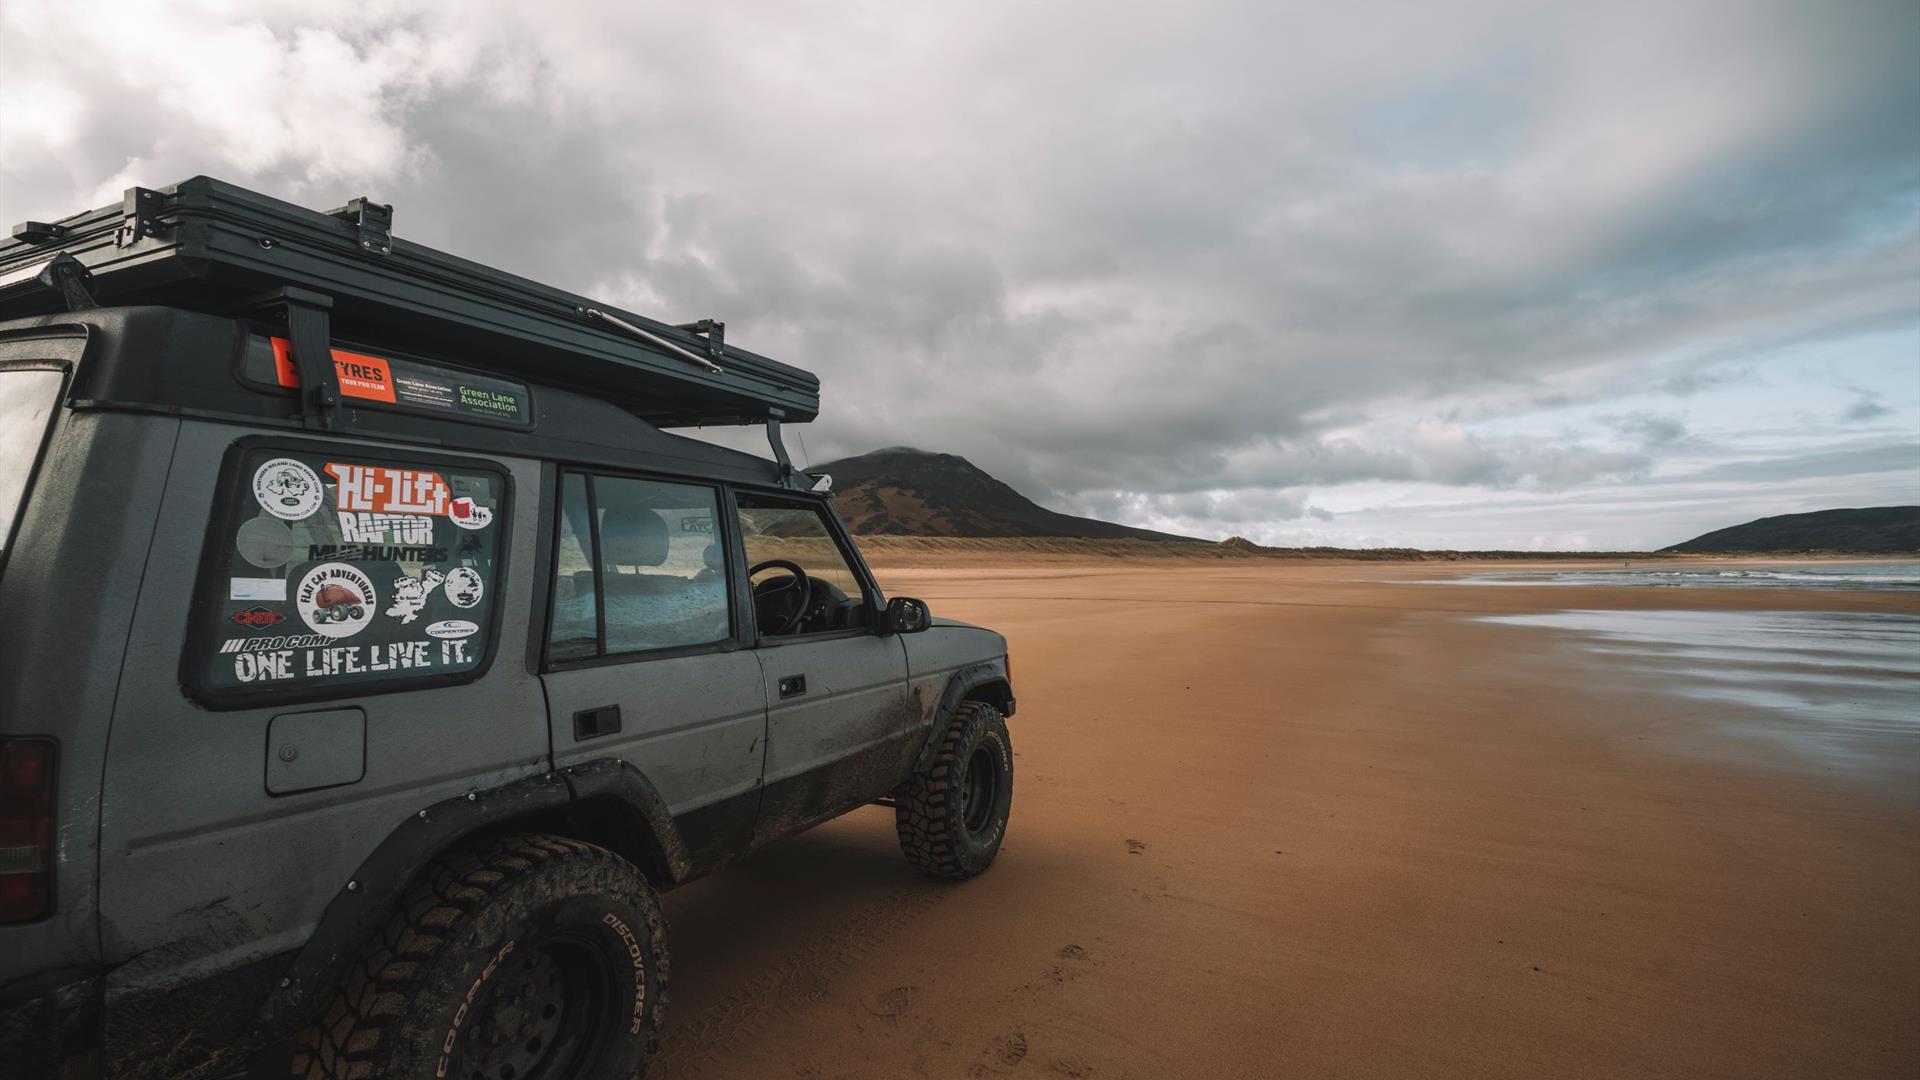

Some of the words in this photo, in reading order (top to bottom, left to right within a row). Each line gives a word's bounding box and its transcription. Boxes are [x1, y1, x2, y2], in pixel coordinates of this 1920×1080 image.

[341, 378, 357, 386] YOUR
[425, 384, 452, 392] Association
[460, 386, 489, 399] Green
[491, 392, 515, 404] Lane
[461, 395, 517, 412] Association
[338, 511, 433, 545] RAPTOR
[300, 584, 315, 603] FLAT
[311, 571, 328, 586] CAP
[330, 569, 374, 605] ADVENTURERS
[242, 636, 286, 651] PRO
[234, 651, 294, 682] ONE
[306, 646, 367, 677] LIFE.
[371, 641, 431, 671] LIVE
[441, 639, 472, 665] IT.
[602, 912, 645, 1035] DISCOVERER
[436, 939, 514, 1078] COOPER
